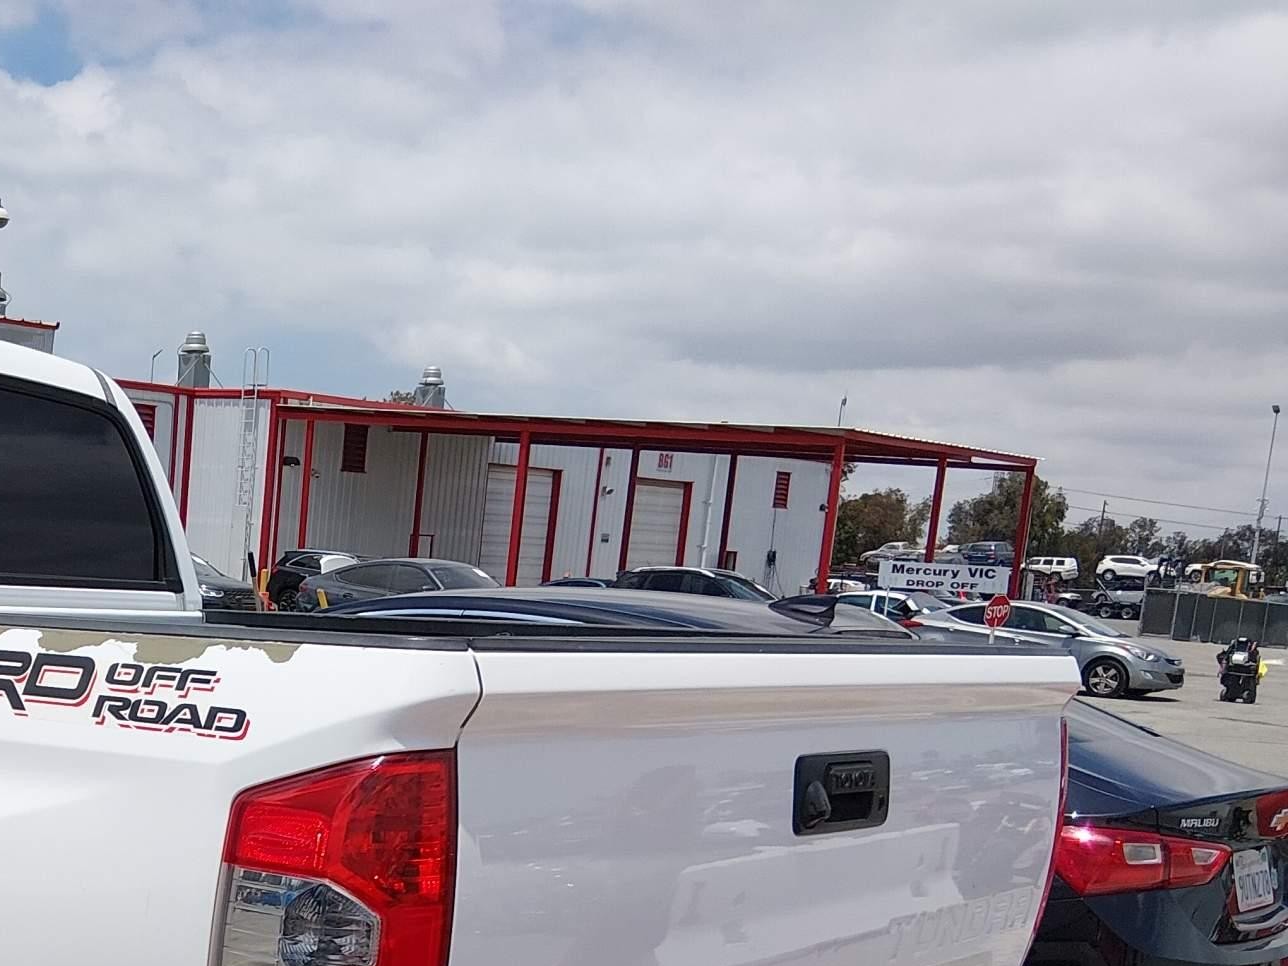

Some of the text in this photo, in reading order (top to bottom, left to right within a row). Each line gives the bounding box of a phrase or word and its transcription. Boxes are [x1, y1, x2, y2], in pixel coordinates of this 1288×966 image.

[891, 564, 997, 579] Mercury VIC
[906, 579, 979, 590] DROP OFF
[987, 605, 1009, 619] STOP
[105, 662, 220, 697] OFF
[92, 694, 250, 740] ROAD
[1180, 818, 1220, 828] MALIBU
